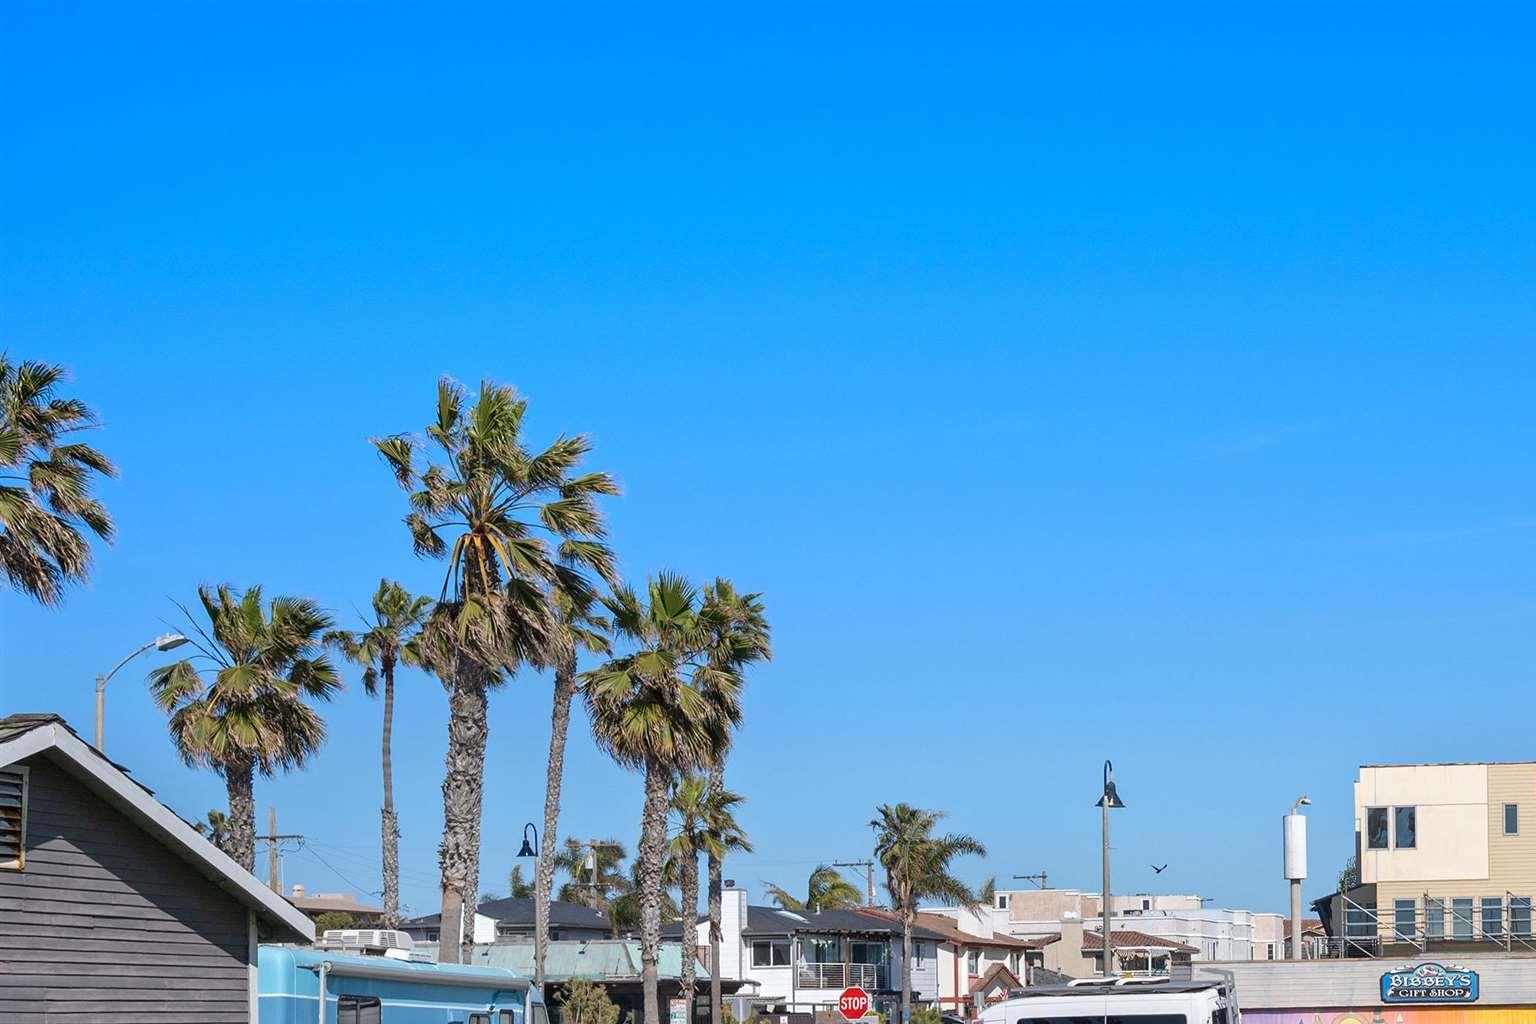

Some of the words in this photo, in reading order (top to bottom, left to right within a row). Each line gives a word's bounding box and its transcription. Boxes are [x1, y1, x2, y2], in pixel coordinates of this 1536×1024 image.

[1390, 974, 1472, 987] BIBBEY'S
[1399, 989, 1427, 997] GIFT
[1429, 988, 1464, 997] SHOP
[841, 997, 867, 1010] STOP
